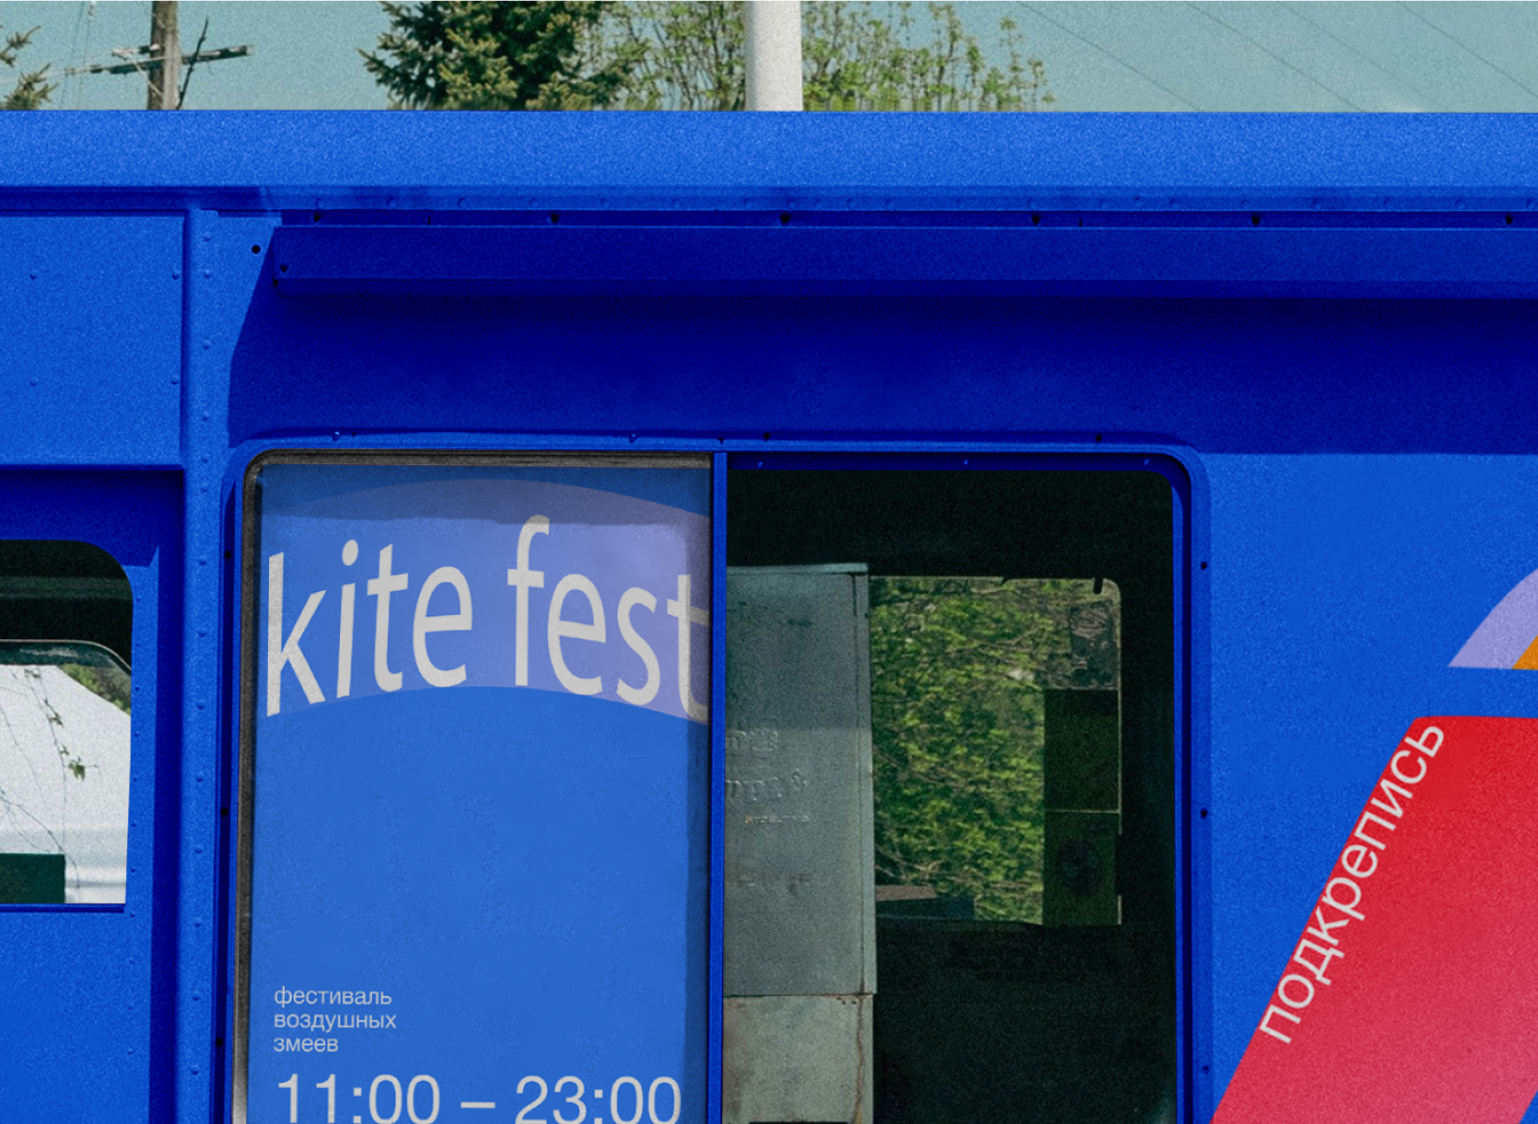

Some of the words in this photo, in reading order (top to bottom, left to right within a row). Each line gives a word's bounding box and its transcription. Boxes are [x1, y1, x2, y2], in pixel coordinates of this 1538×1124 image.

[267, 539, 473, 717] kite
[507, 514, 708, 721] fest
[1259, 724, 1444, 1044] подкрепись
[273, 985, 392, 1009] фестиваль
[273, 1013, 397, 1033] воздушных
[273, 1036, 339, 1053] змеев
